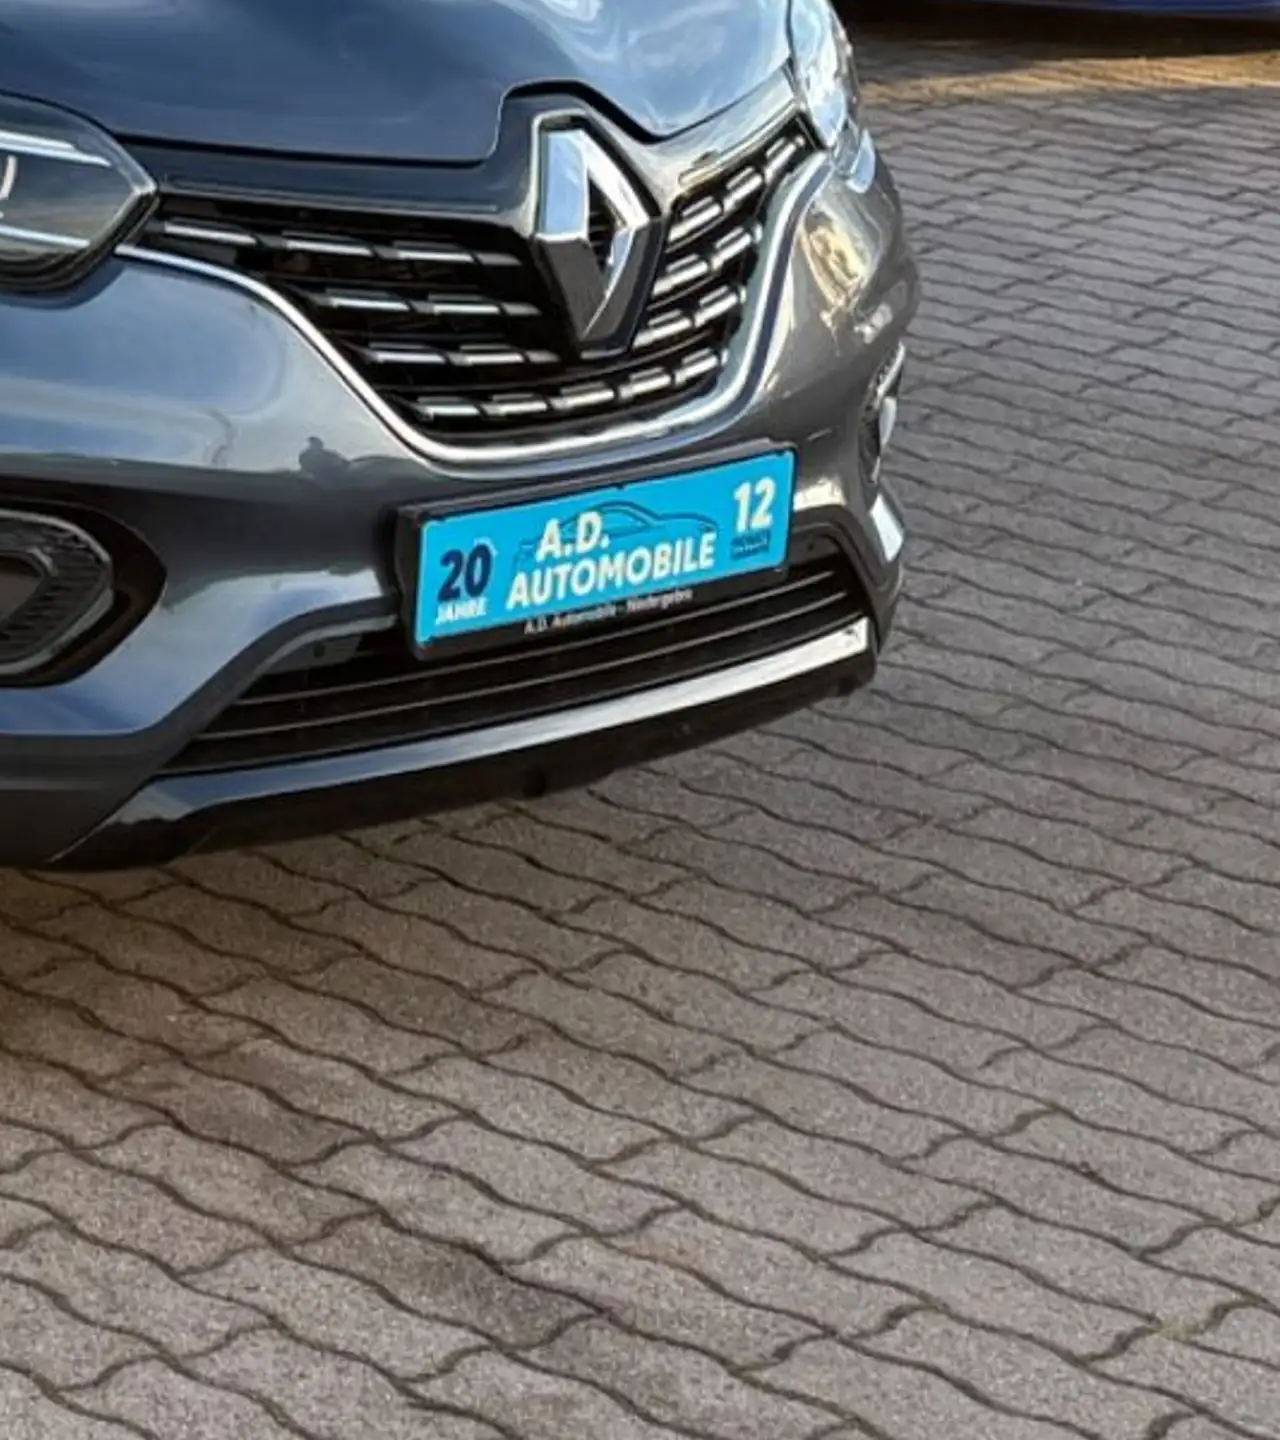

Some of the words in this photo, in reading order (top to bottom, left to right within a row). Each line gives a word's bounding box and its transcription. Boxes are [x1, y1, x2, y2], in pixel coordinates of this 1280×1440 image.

[438, 545, 493, 602] 20
[535, 510, 611, 562] A.D.
[733, 476, 777, 534] 12
[506, 533, 718, 611] AUTOMOBILE
